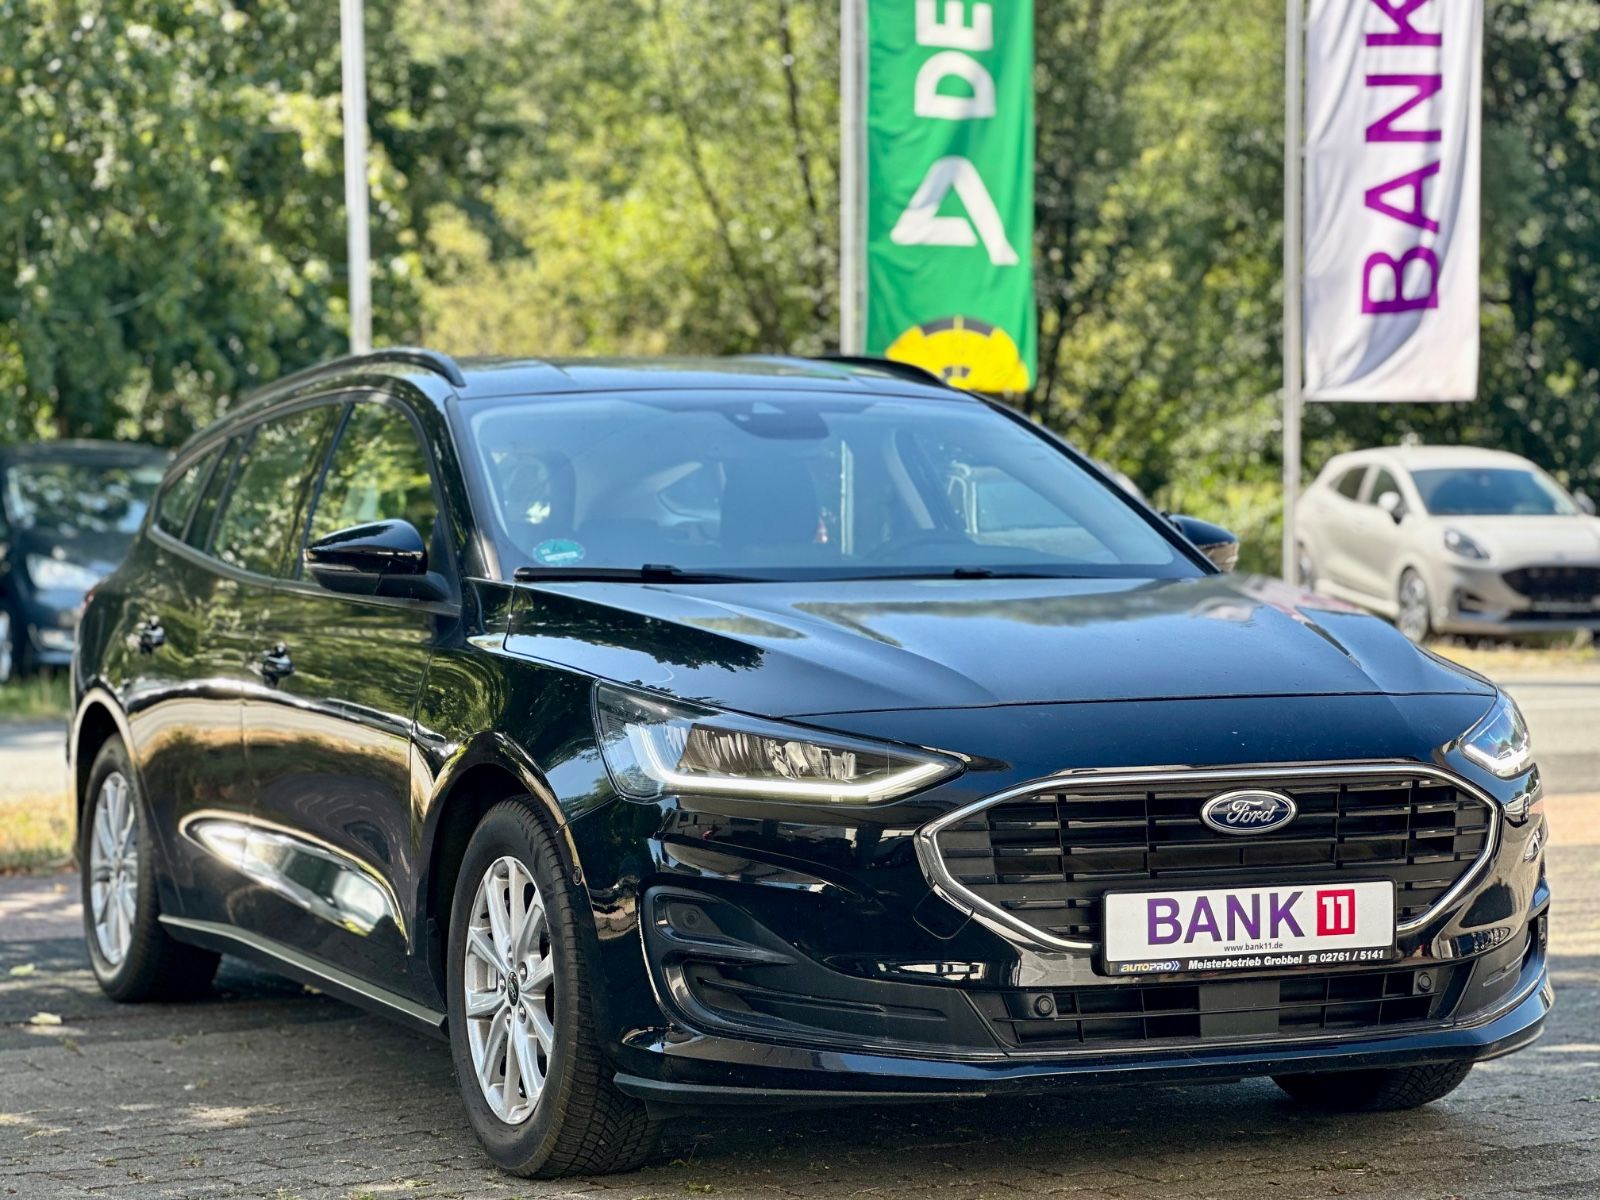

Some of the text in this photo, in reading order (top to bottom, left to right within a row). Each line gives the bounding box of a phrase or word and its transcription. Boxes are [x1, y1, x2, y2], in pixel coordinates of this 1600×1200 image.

[914, 0, 996, 120] DE
[1362, 0, 1442, 314] BANK
[1226, 799, 1275, 824] Ford
[1147, 891, 1351, 946] BANK 11
[1188, 957, 1260, 969] Meisterbetrieb
[1264, 954, 1303, 966] Grobbel
[1320, 951, 1350, 963] 02761
[1360, 949, 1384, 960] 5141
[1224, 942, 1283, 952] www.bank11.de
